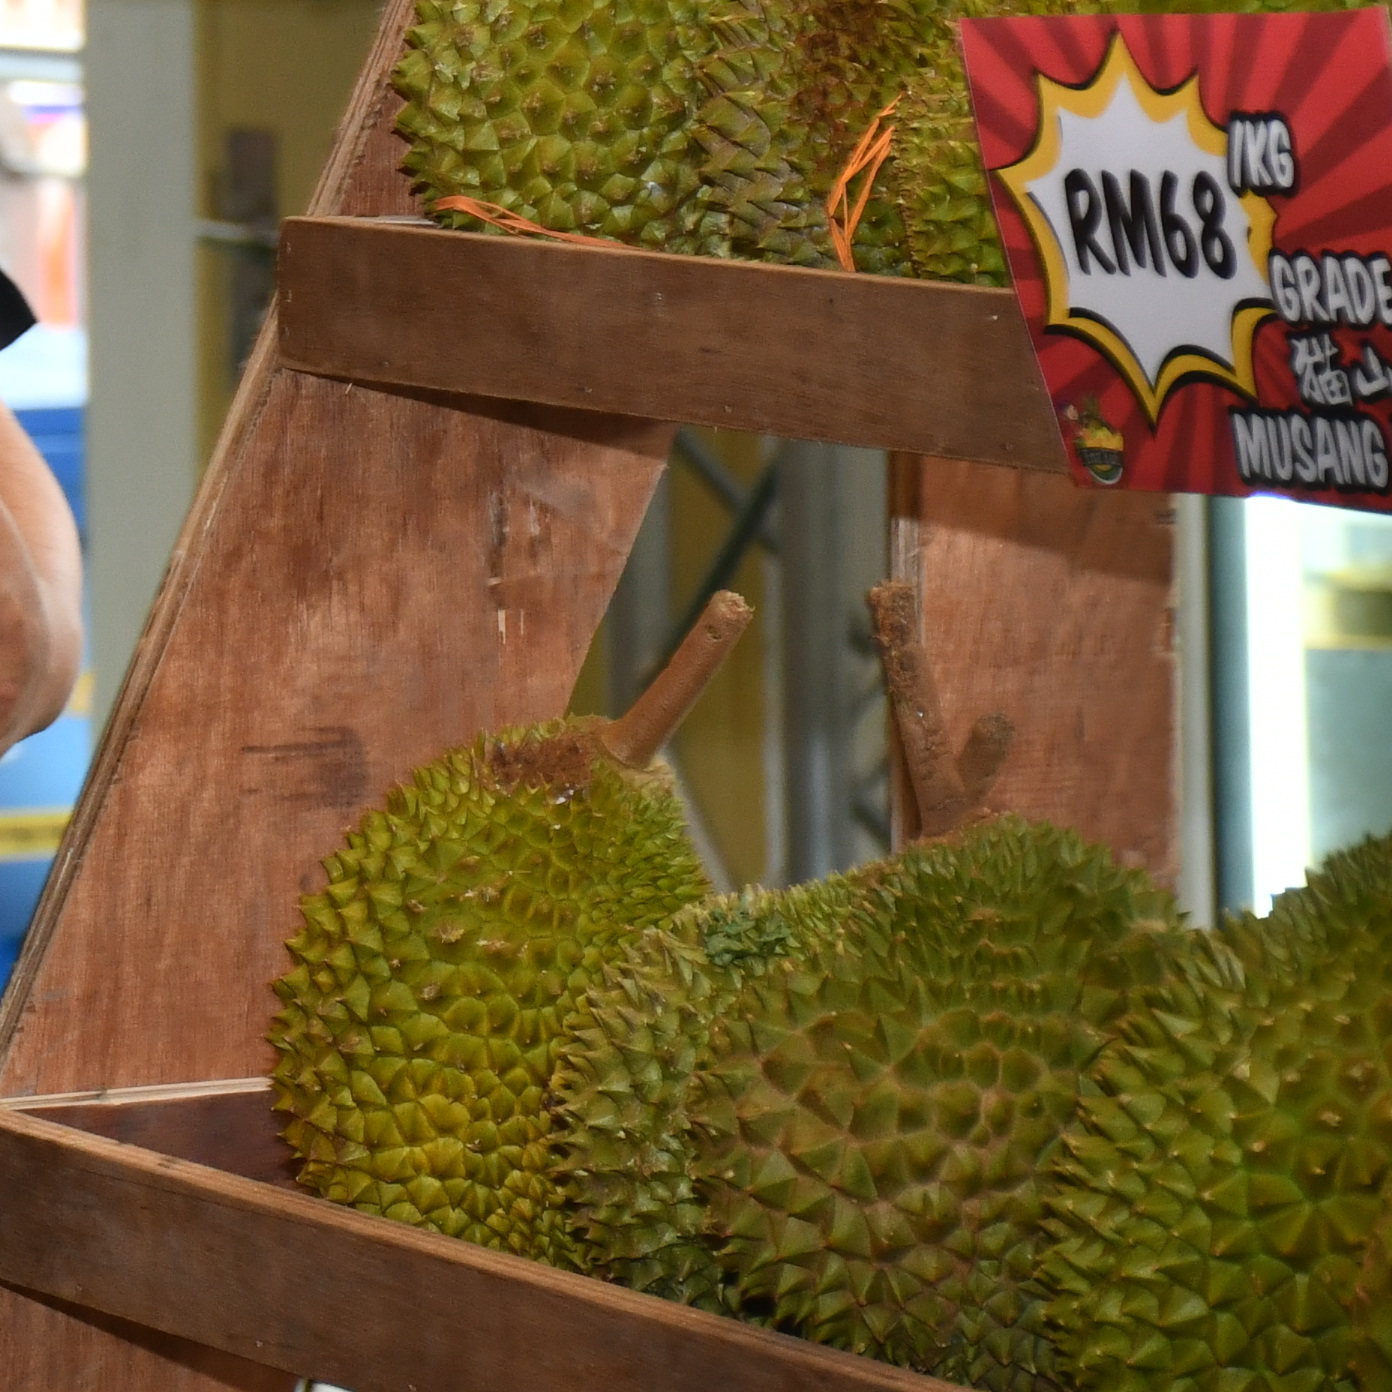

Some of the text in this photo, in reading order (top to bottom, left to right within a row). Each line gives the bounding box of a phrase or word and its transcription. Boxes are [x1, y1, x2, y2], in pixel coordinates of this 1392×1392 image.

[1064, 167, 1238, 281] RM68
[1269, 252, 1392, 326] GRADE
[1231, 411, 1390, 489] MUSANG
